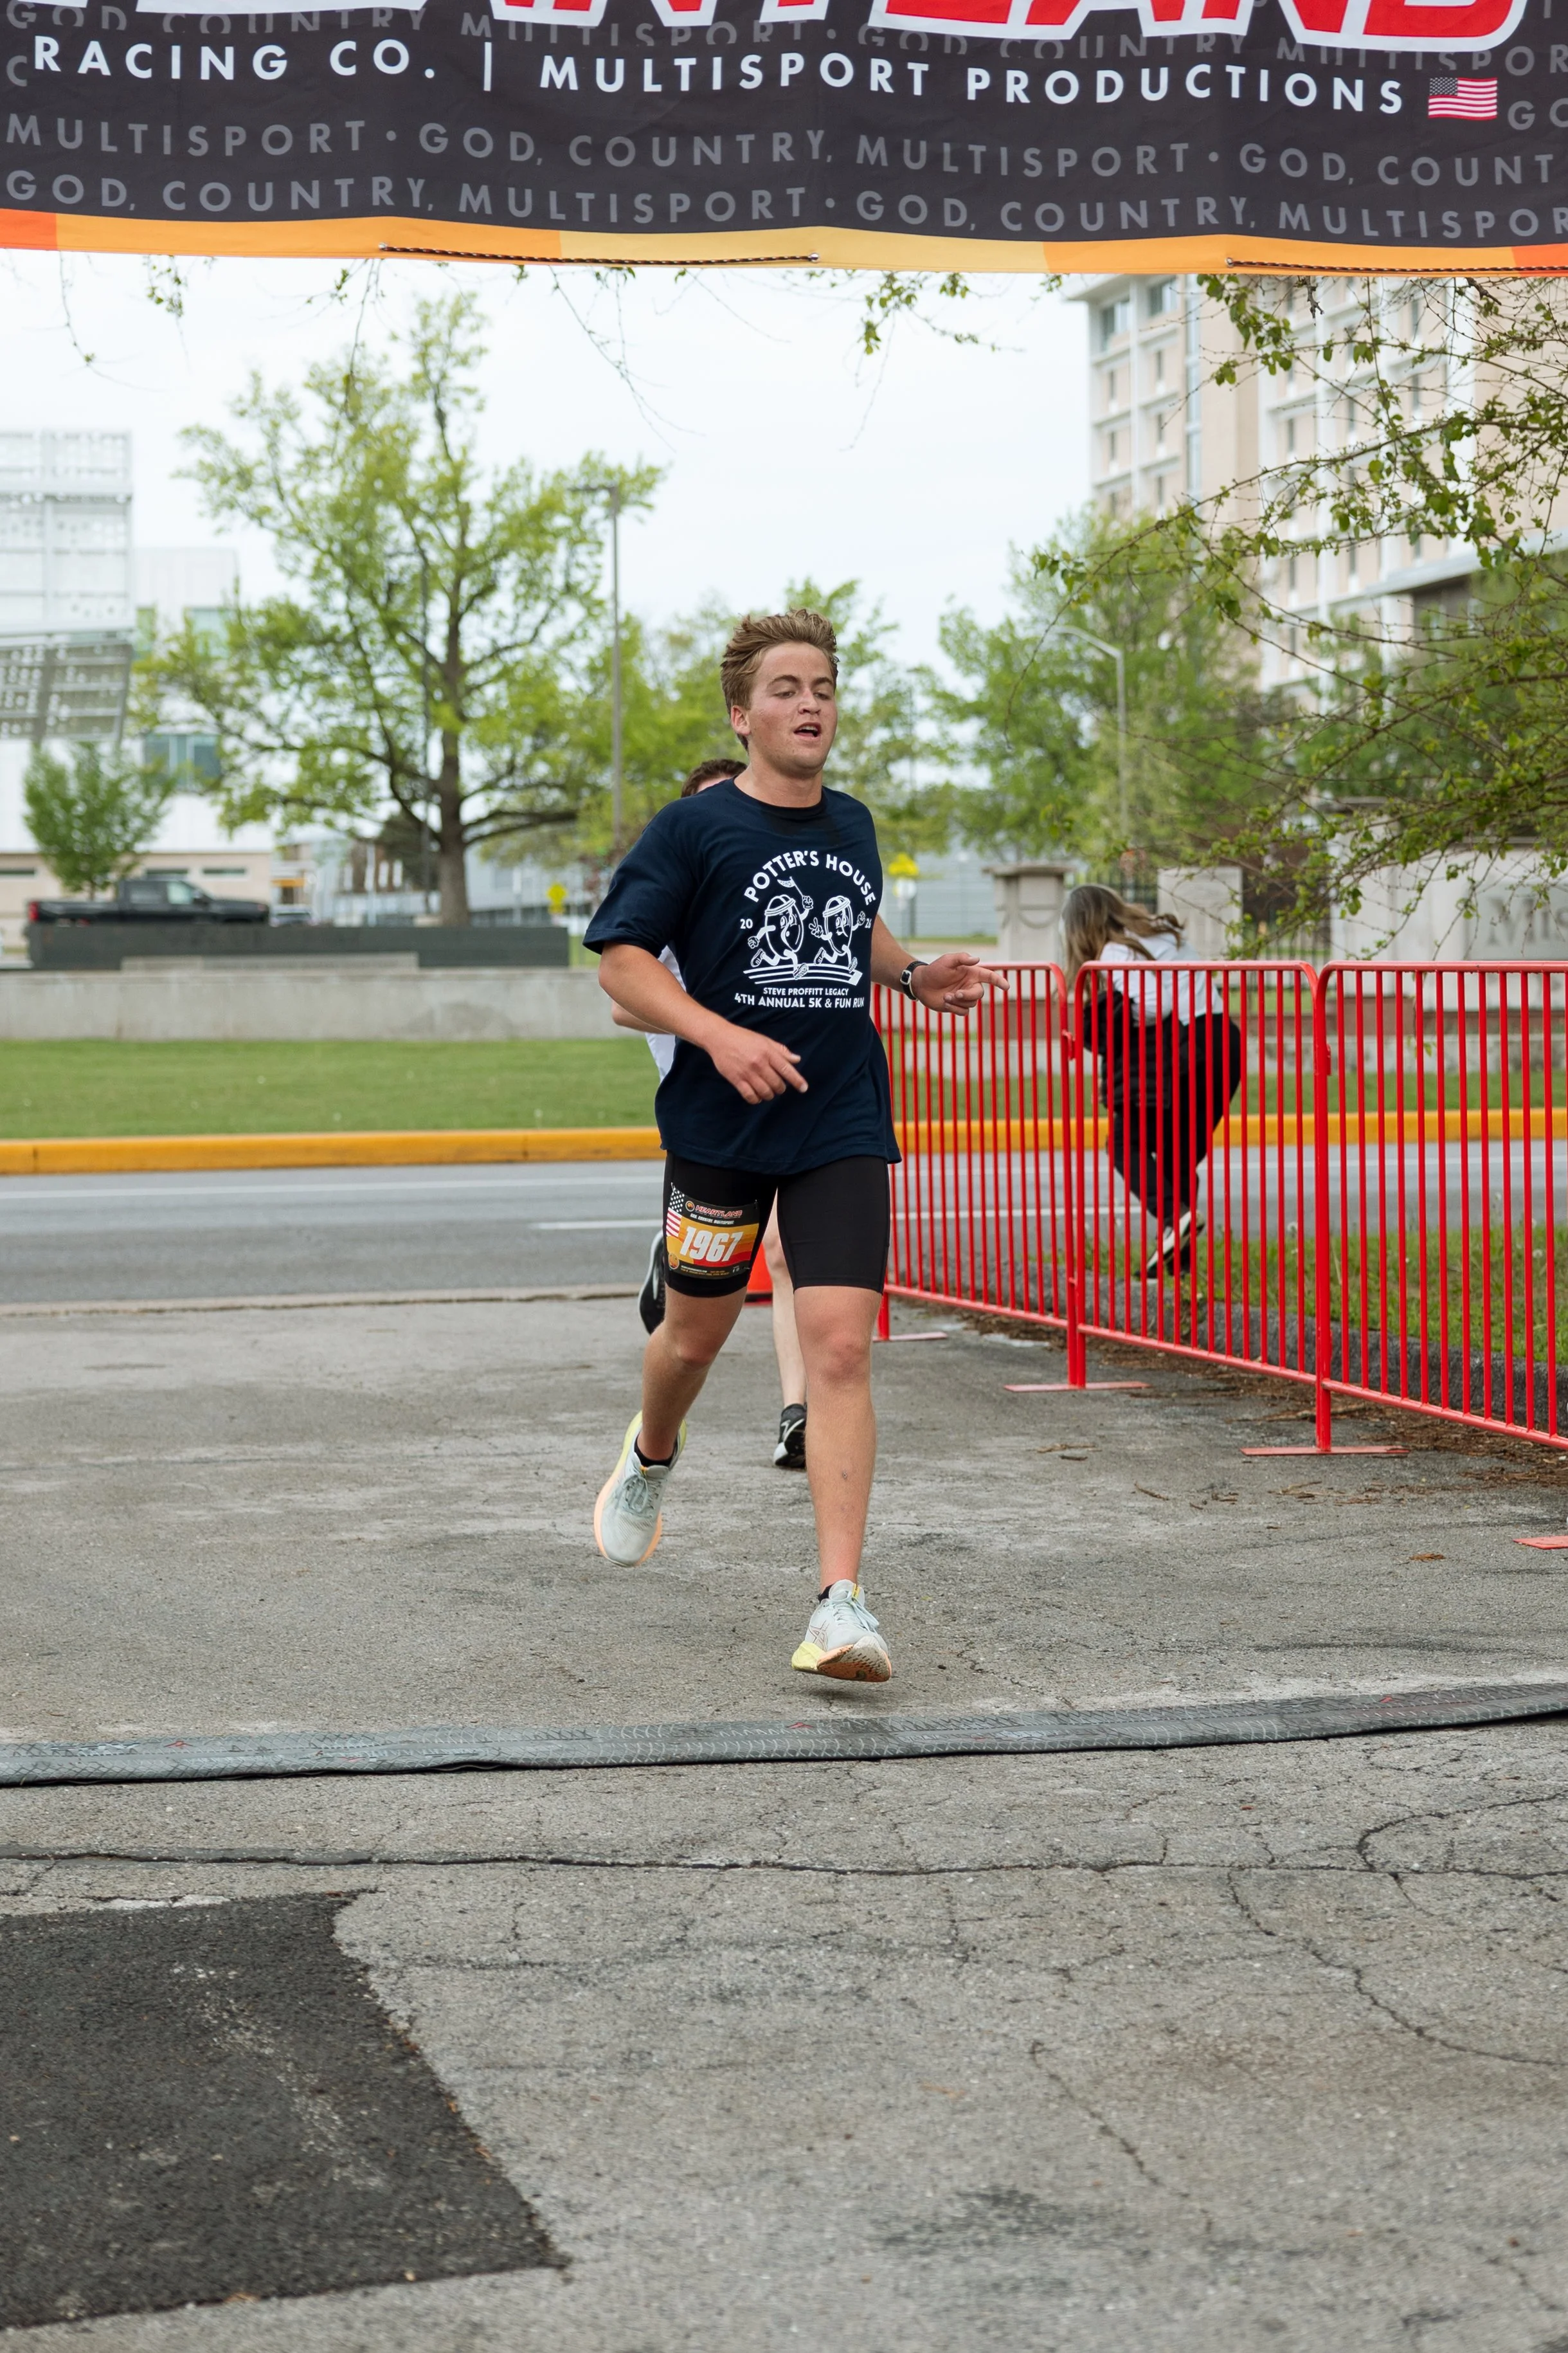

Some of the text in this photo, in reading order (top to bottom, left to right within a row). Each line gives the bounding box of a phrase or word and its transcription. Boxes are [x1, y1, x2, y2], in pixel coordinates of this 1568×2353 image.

[34, 35, 289, 81] RACING
[329, 39, 436, 80] CO.
[539, 52, 930, 96] MULTISPORT
[967, 63, 1403, 115] PRODUCTIONS
[6, 113, 1554, 186] MULTISPORT GOD, COUNTRY, MULTISPORT GOD, COUNT
[6, 170, 136, 211] GOD,
[163, 176, 434, 213] COUNTRY,
[459, 183, 806, 223] MULTISPORT
[856, 190, 976, 231] GOD,
[1000, 196, 1256, 232] COUNTRY,
[744, 850, 876, 905] POTTER'S HOUSE
[740, 918, 753, 929] 20
[734, 992, 865, 1008] 4TH ANNUAL 5K & FUN RUN
[763, 987, 849, 996] STEVE PROFFITT LEGACY
[680, 1226, 744, 1262] 1967
